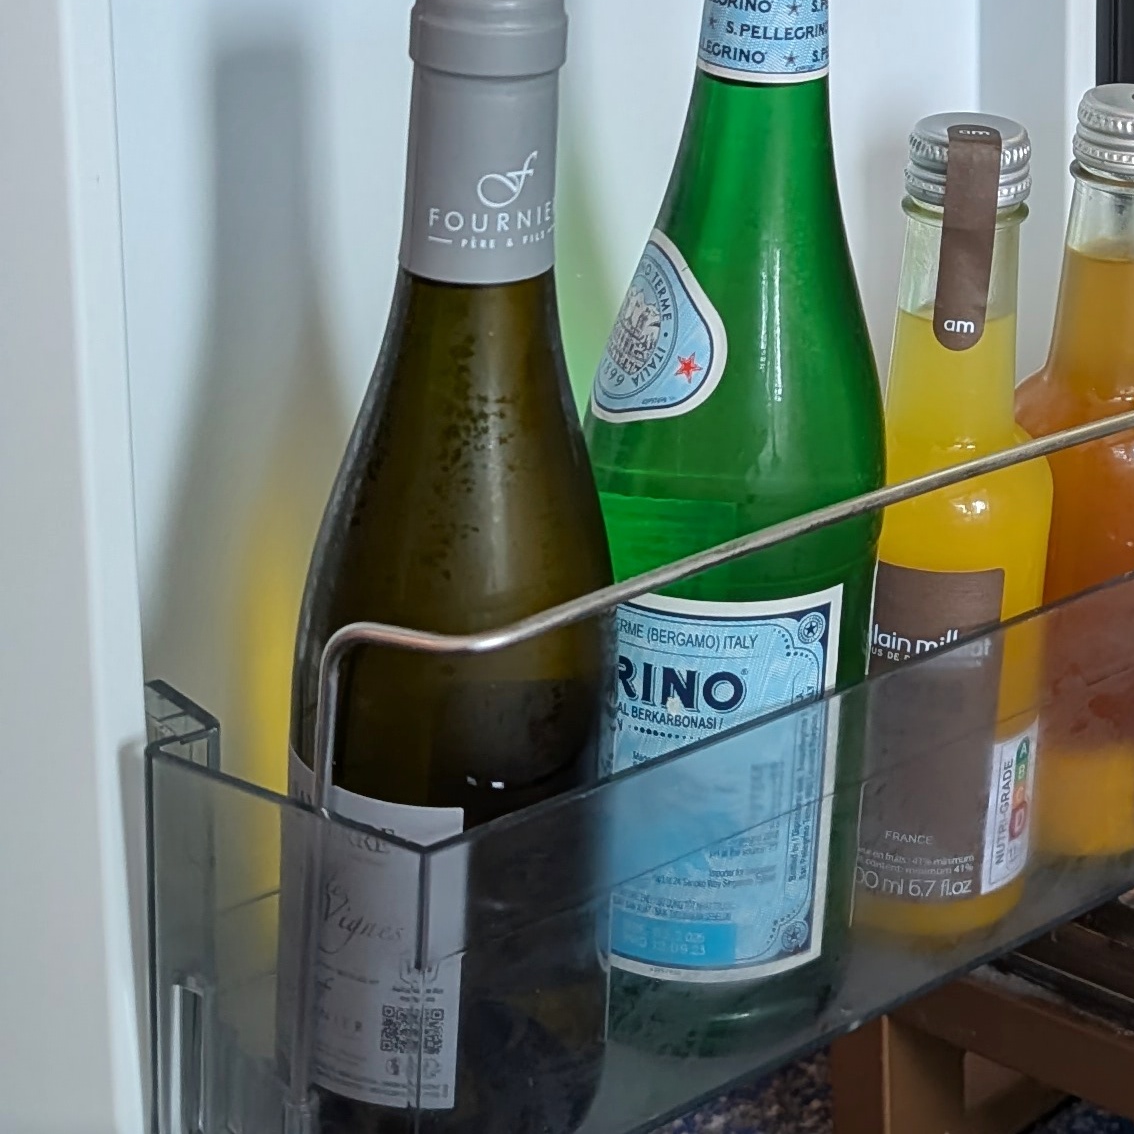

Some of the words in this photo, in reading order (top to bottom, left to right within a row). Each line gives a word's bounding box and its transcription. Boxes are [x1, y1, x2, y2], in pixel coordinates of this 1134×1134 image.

[428, 201, 552, 233] FOURNIE
[522, 230, 545, 244] FILS
[652, 271, 672, 322] TERME
[943, 319, 975, 334] am
[631, 346, 666, 388] ITALIA
[647, 627, 720, 653] (BERGAMO)
[723, 634, 758, 650] ITALY
[873, 623, 911, 653] lain
[887, 650, 900, 662] DE
[631, 705, 717, 730] BERKARBONASI
[1019, 743, 1028, 756] A
[1018, 764, 1026, 780] B
[995, 758, 1013, 865] NUTRI-GRADE
[1013, 810, 1027, 831] D
[885, 830, 934, 845] FRANCE
[883, 876, 904, 895] ml
[908, 879, 936, 897] 6.7
[940, 878, 972, 897] fl.oz
[319, 892, 404, 955] Vignes
